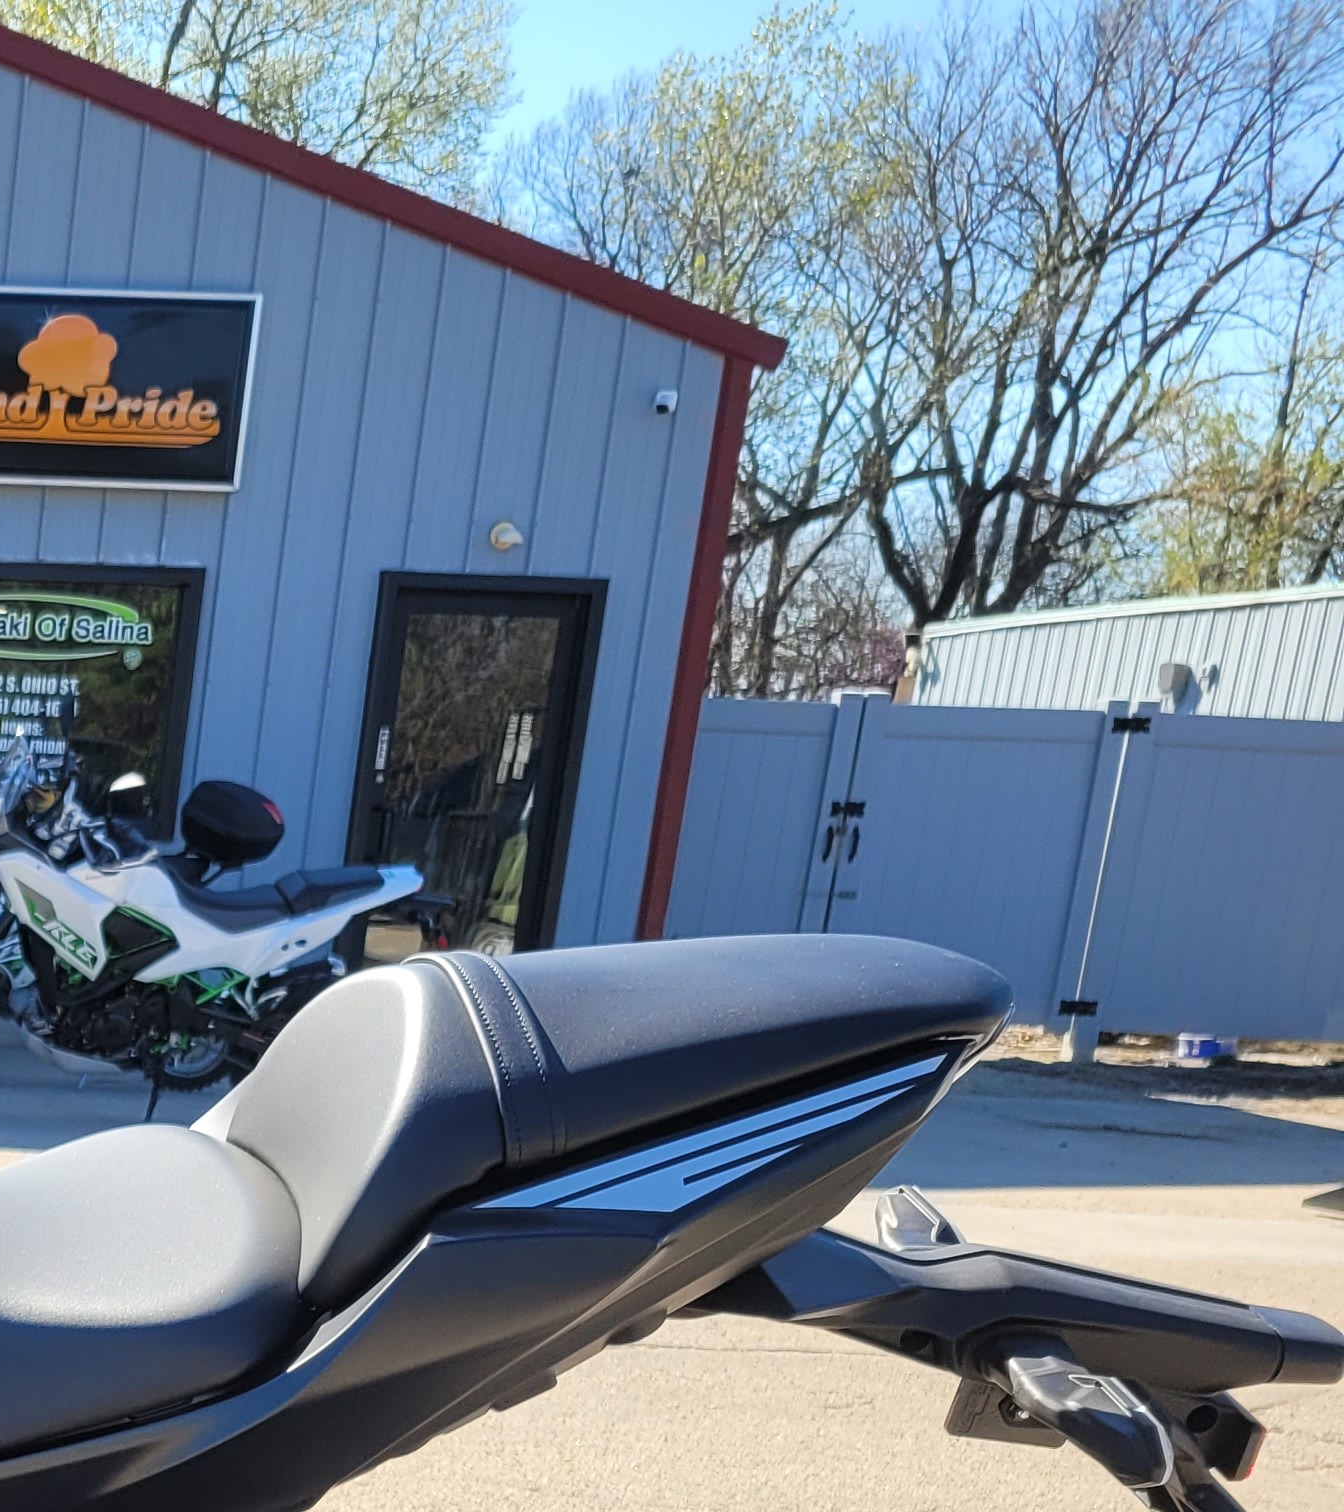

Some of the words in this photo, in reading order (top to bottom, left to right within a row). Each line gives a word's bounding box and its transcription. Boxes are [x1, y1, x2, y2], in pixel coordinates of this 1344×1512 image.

[75, 385, 218, 431] Pride
[37, 615, 68, 641] Of
[74, 617, 152, 643] Salina
[6, 674, 20, 692] S.
[21, 675, 58, 695] OHIO
[59, 677, 81, 696] ST.
